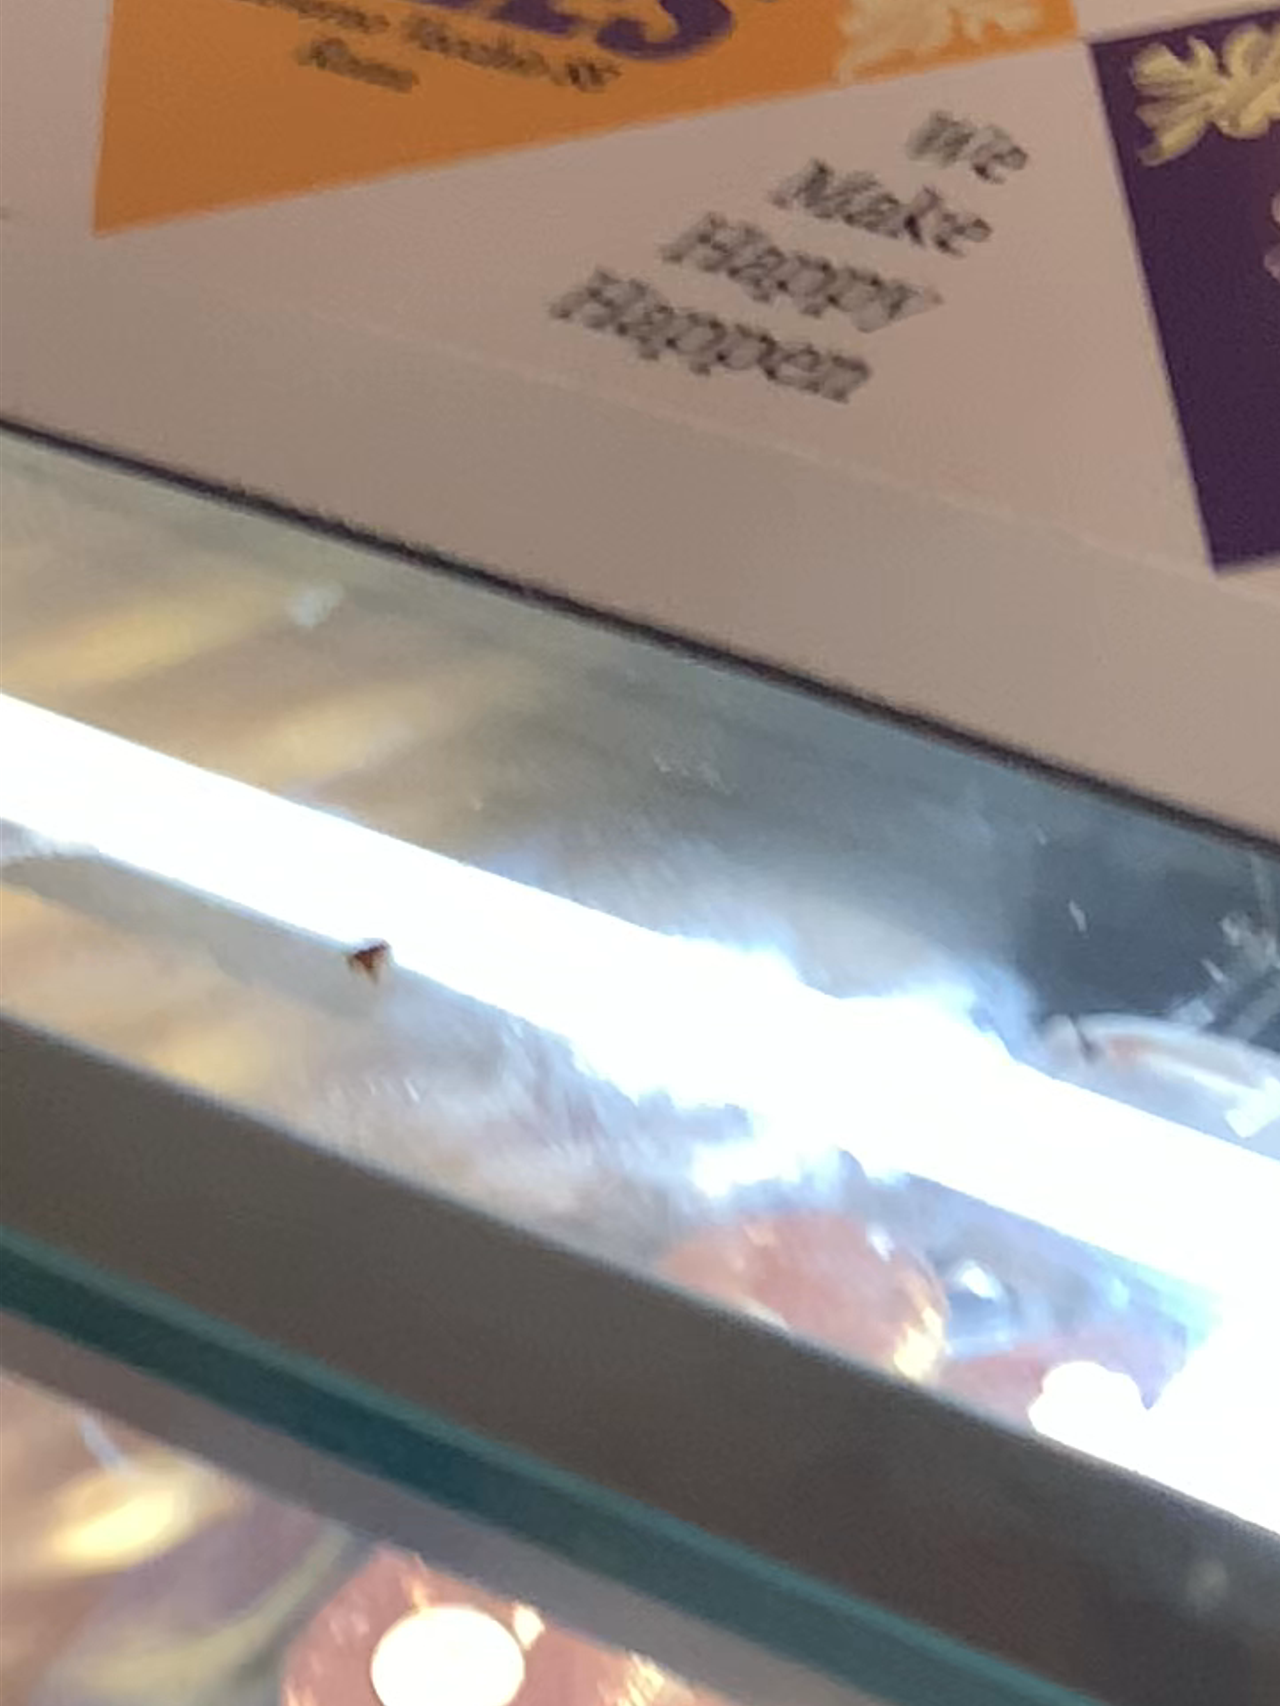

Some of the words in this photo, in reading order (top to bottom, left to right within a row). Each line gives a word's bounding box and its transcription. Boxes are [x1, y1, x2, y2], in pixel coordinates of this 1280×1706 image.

[769, 158, 993, 258] Make
[660, 211, 944, 334] Happy
[547, 267, 871, 405] Happen
